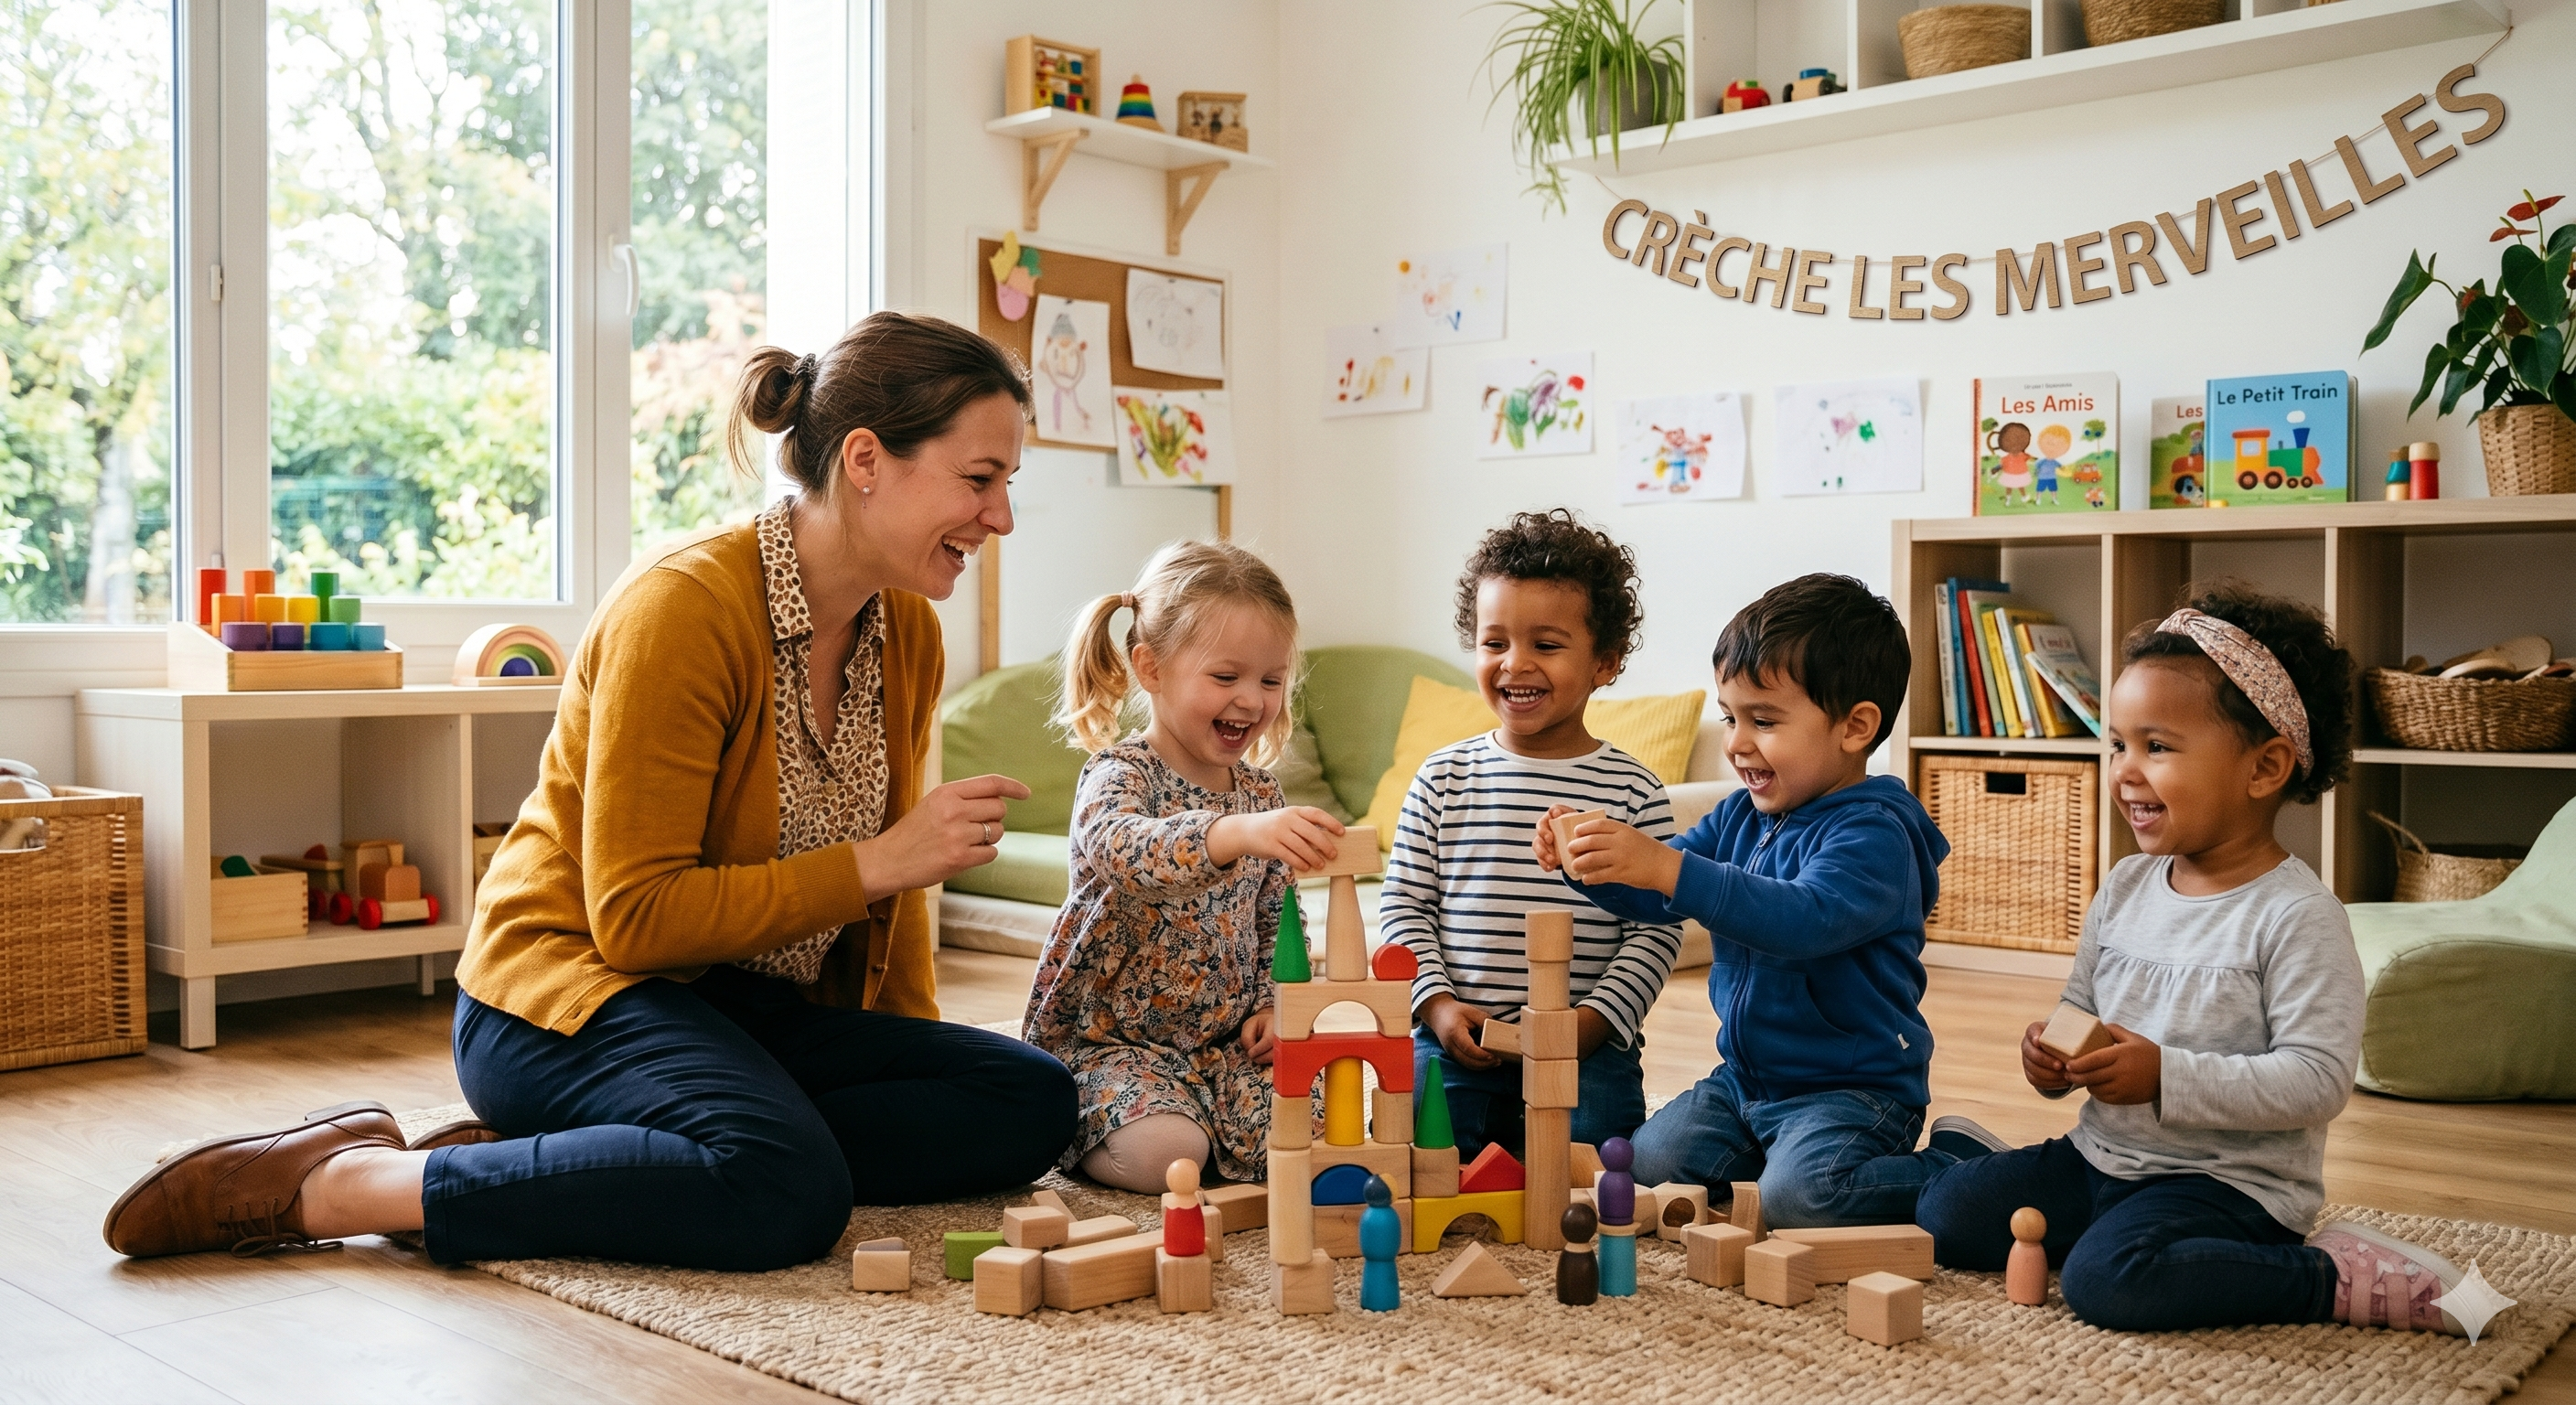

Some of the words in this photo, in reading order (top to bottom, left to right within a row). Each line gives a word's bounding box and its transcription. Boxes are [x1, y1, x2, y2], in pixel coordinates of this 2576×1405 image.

[1602, 198, 1832, 316] CRÈCHE
[1848, 254, 1970, 321] LES
[1995, 63, 2507, 316] MERVEILLES
[2002, 396, 2035, 414] Les
[2043, 392, 2094, 413] Amis
[2217, 391, 2237, 405] Le
[2242, 386, 2284, 403] Petit
[2291, 382, 2338, 401] Train
[2176, 404, 2204, 419] Les
